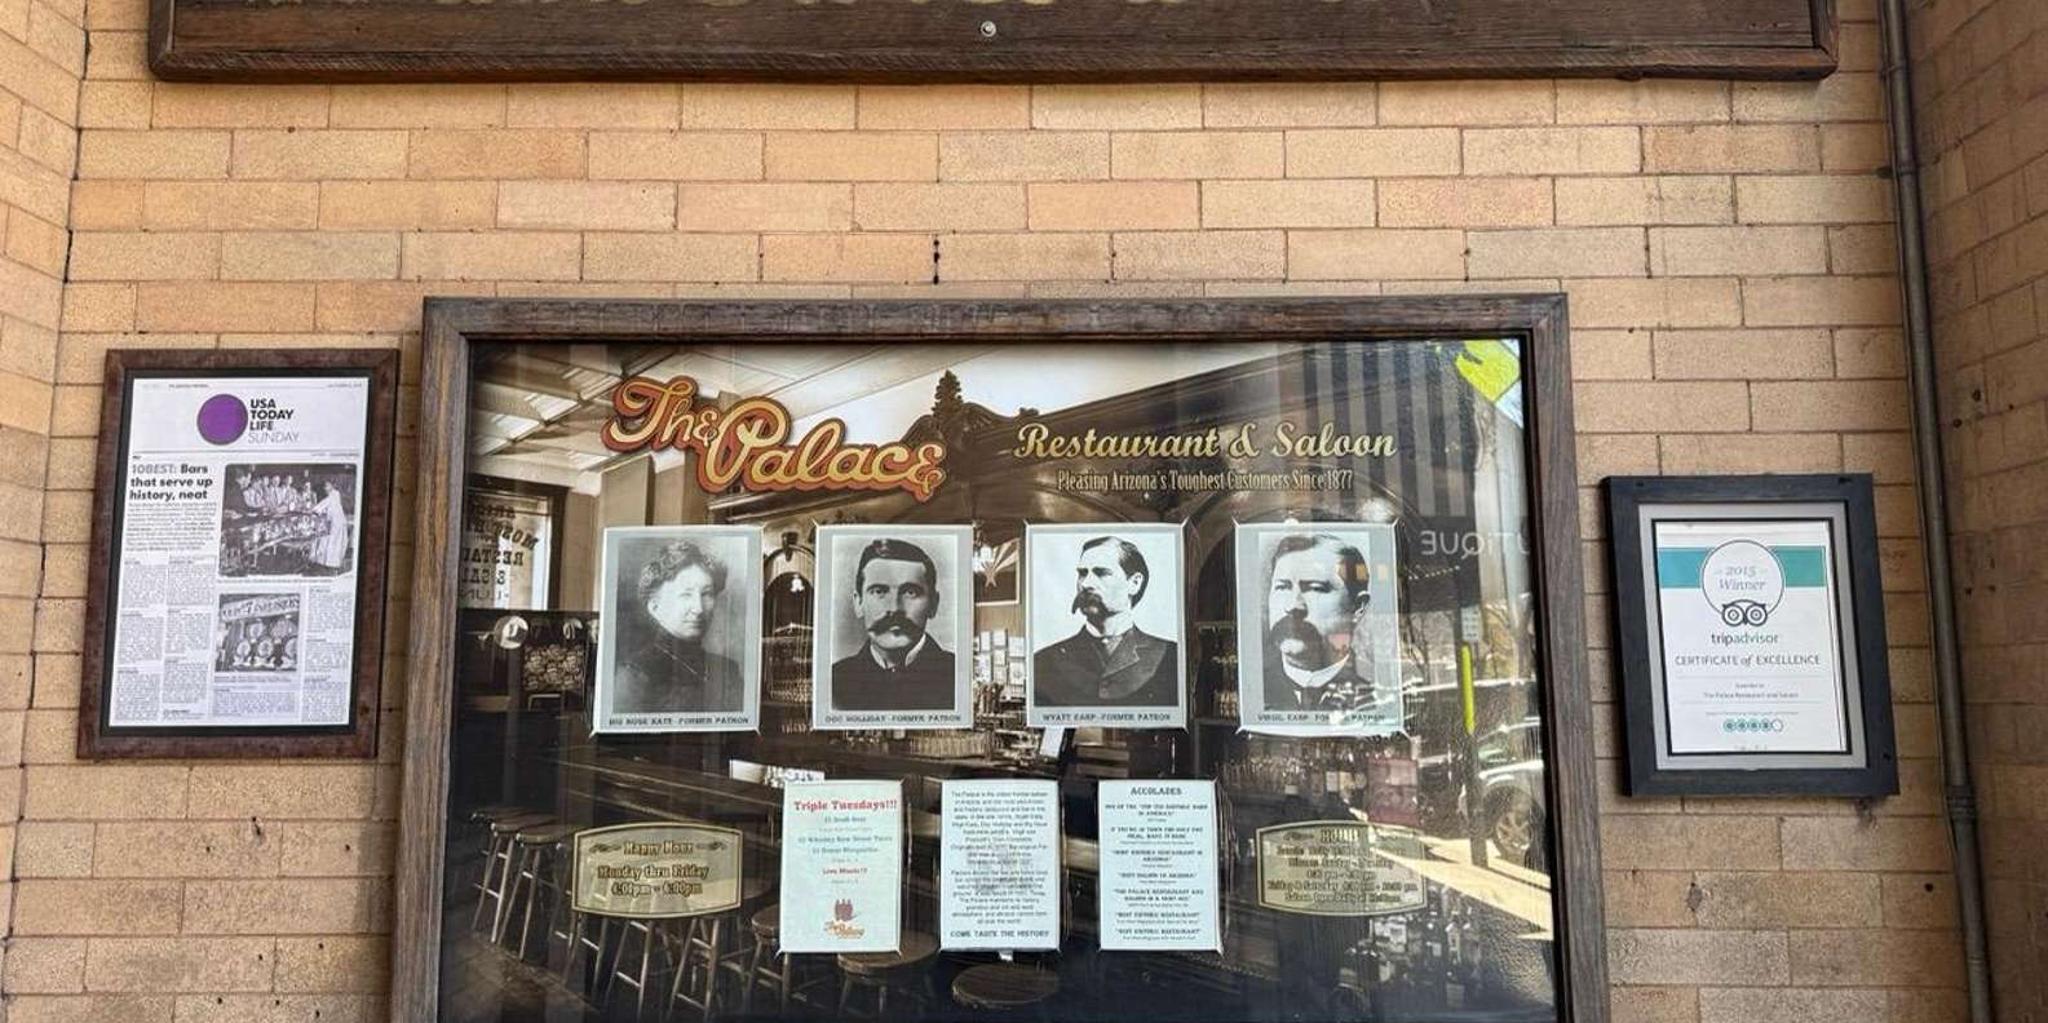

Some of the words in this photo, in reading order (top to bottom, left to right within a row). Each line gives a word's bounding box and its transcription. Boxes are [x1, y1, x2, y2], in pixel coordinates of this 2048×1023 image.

[250, 399, 276, 409] USA
[250, 410, 294, 420] TODAY
[250, 421, 273, 431] LIFE
[248, 432, 299, 444] SUNDAY
[601, 375, 720, 451] The
[700, 395, 947, 504] Palace
[1013, 423, 1221, 459] Restaurant
[1229, 423, 1260, 459] &
[1271, 421, 1398, 459] Saloon
[132, 464, 177, 474] 10BEST:
[180, 463, 208, 474] Bars
[130, 477, 156, 487] that
[159, 478, 193, 487] serve
[197, 478, 213, 490] up
[1058, 470, 1108, 492] Pleasing
[1112, 470, 1168, 490] Arizona's
[1170, 470, 1225, 491] Toughest
[1228, 470, 1289, 490] Customers
[1293, 470, 1325, 490] Since
[1327, 470, 1353, 491] 1877
[130, 490, 176, 502] history,
[179, 490, 208, 500] neat
[1726, 566, 1756, 577] 2015
[1719, 579, 1765, 591] Winner
[1711, 632, 1779, 647] tripadvisor
[1675, 655, 1738, 666] CERTIFICATE
[1740, 654, 1752, 667] of
[1756, 655, 1821, 665] EXCELLENCE
[651, 717, 672, 725] KATE
[678, 717, 712, 725] FORMER
[716, 716, 749, 724] PATRON
[1074, 713, 1097, 721] EARP
[1101, 713, 1135, 721] FORMER
[1138, 713, 1170, 721] PATRON
[1258, 714, 1284, 722] VIRGIL
[1131, 787, 1182, 795] ACCOLADES
[794, 801, 827, 812] Triple
[833, 800, 897, 811] Tuesdays!!!
[624, 841, 660, 856] Happy
[663, 840, 694, 854] Hour
[598, 865, 642, 880] Monday
[644, 865, 670, 878] thru
[672, 864, 709, 880] Friday
